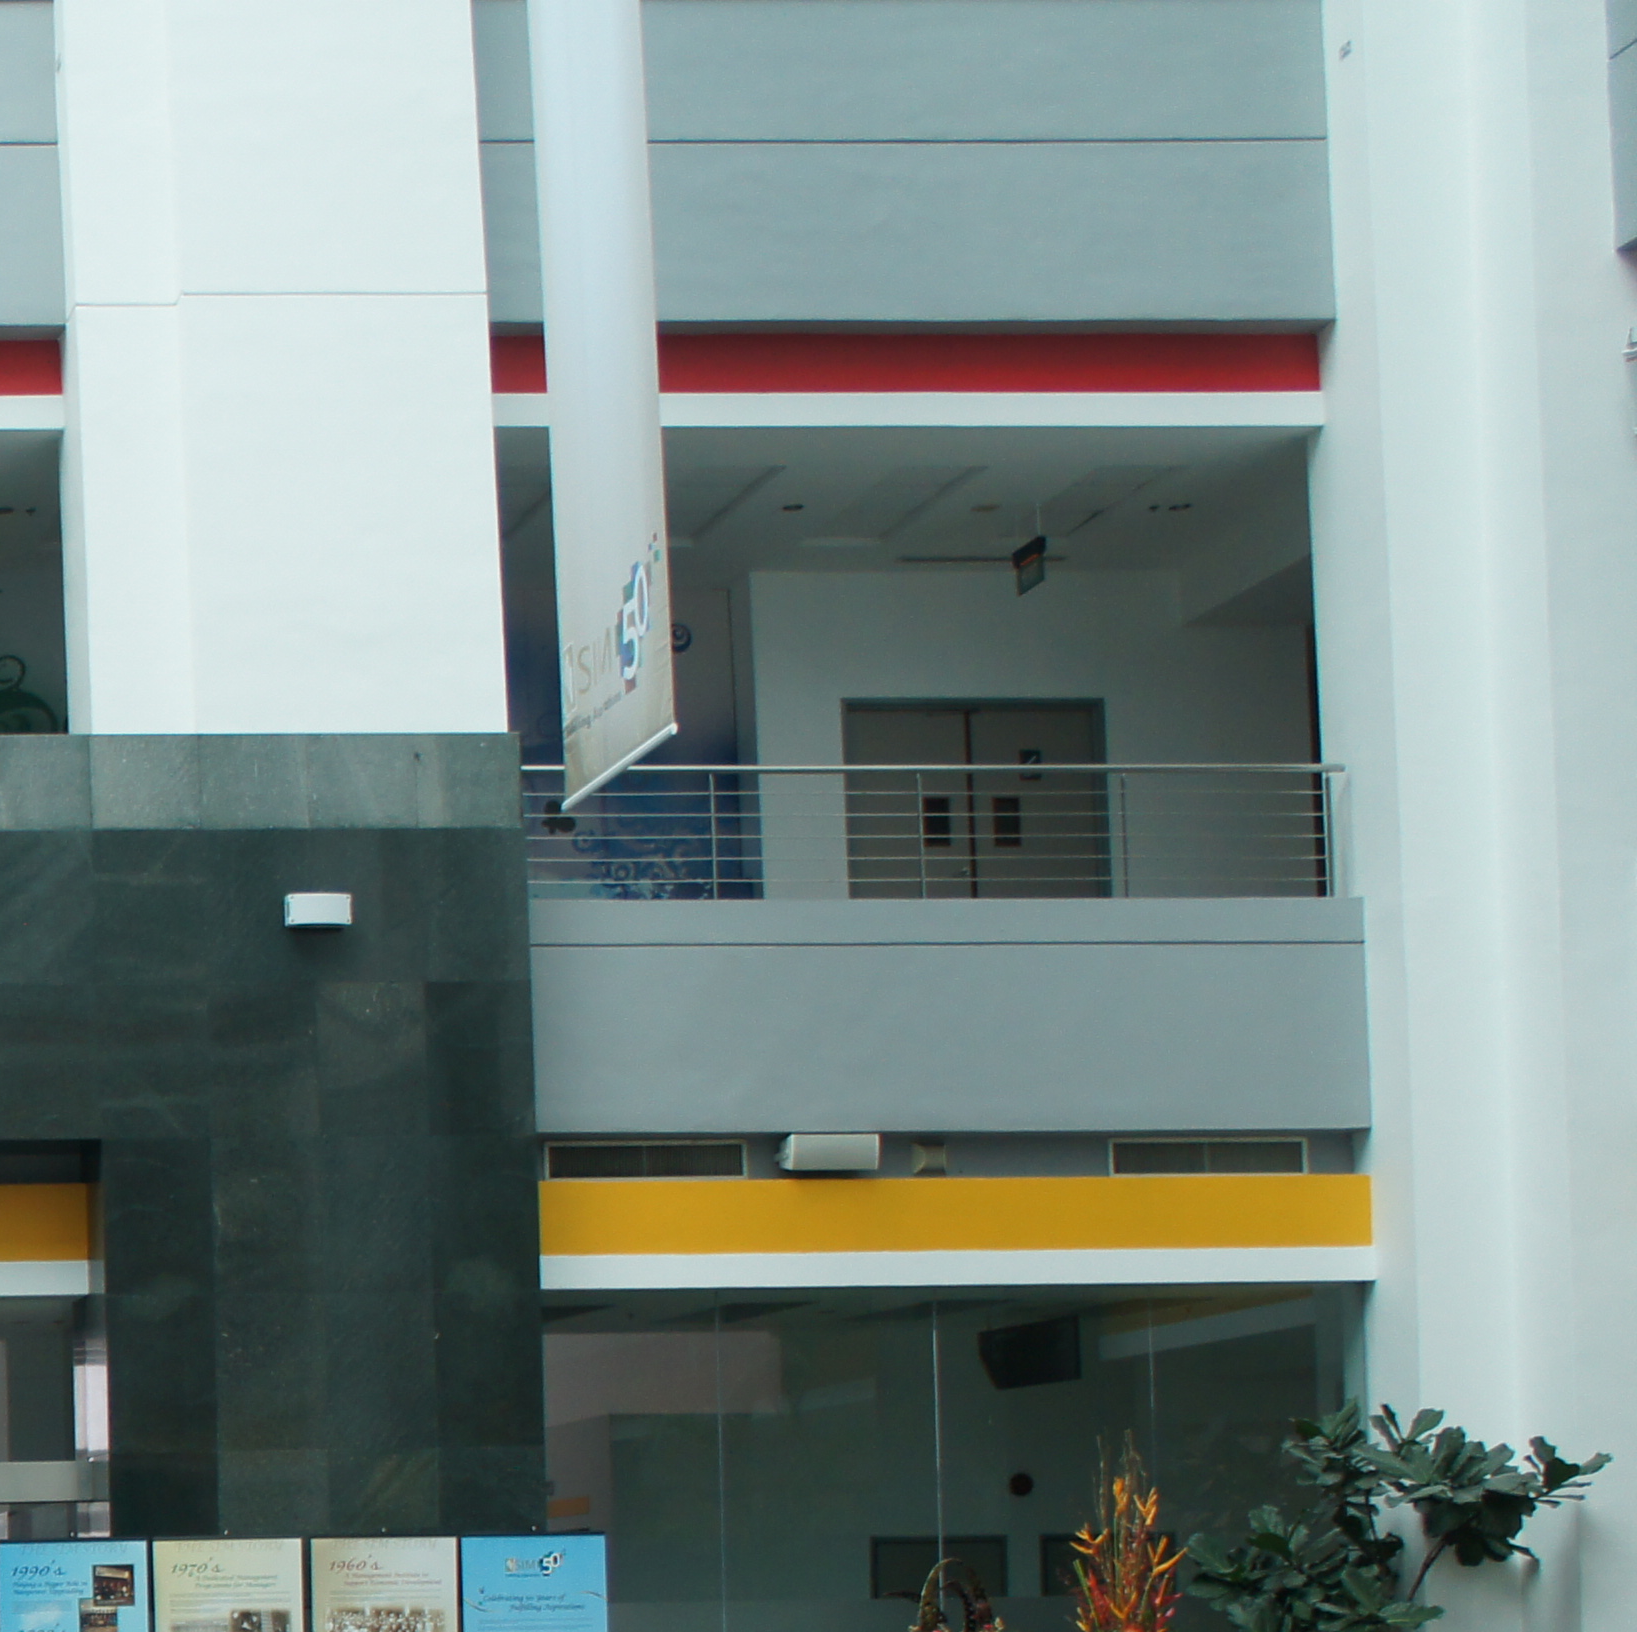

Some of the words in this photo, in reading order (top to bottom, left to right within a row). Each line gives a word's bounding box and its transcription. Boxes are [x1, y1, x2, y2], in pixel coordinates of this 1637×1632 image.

[623, 565, 649, 680] 50
[12, 1560, 66, 1580] 1990's
[172, 1557, 225, 1577] 1970's
[330, 1555, 382, 1574] 1960's
[542, 1553, 561, 1574] 50
